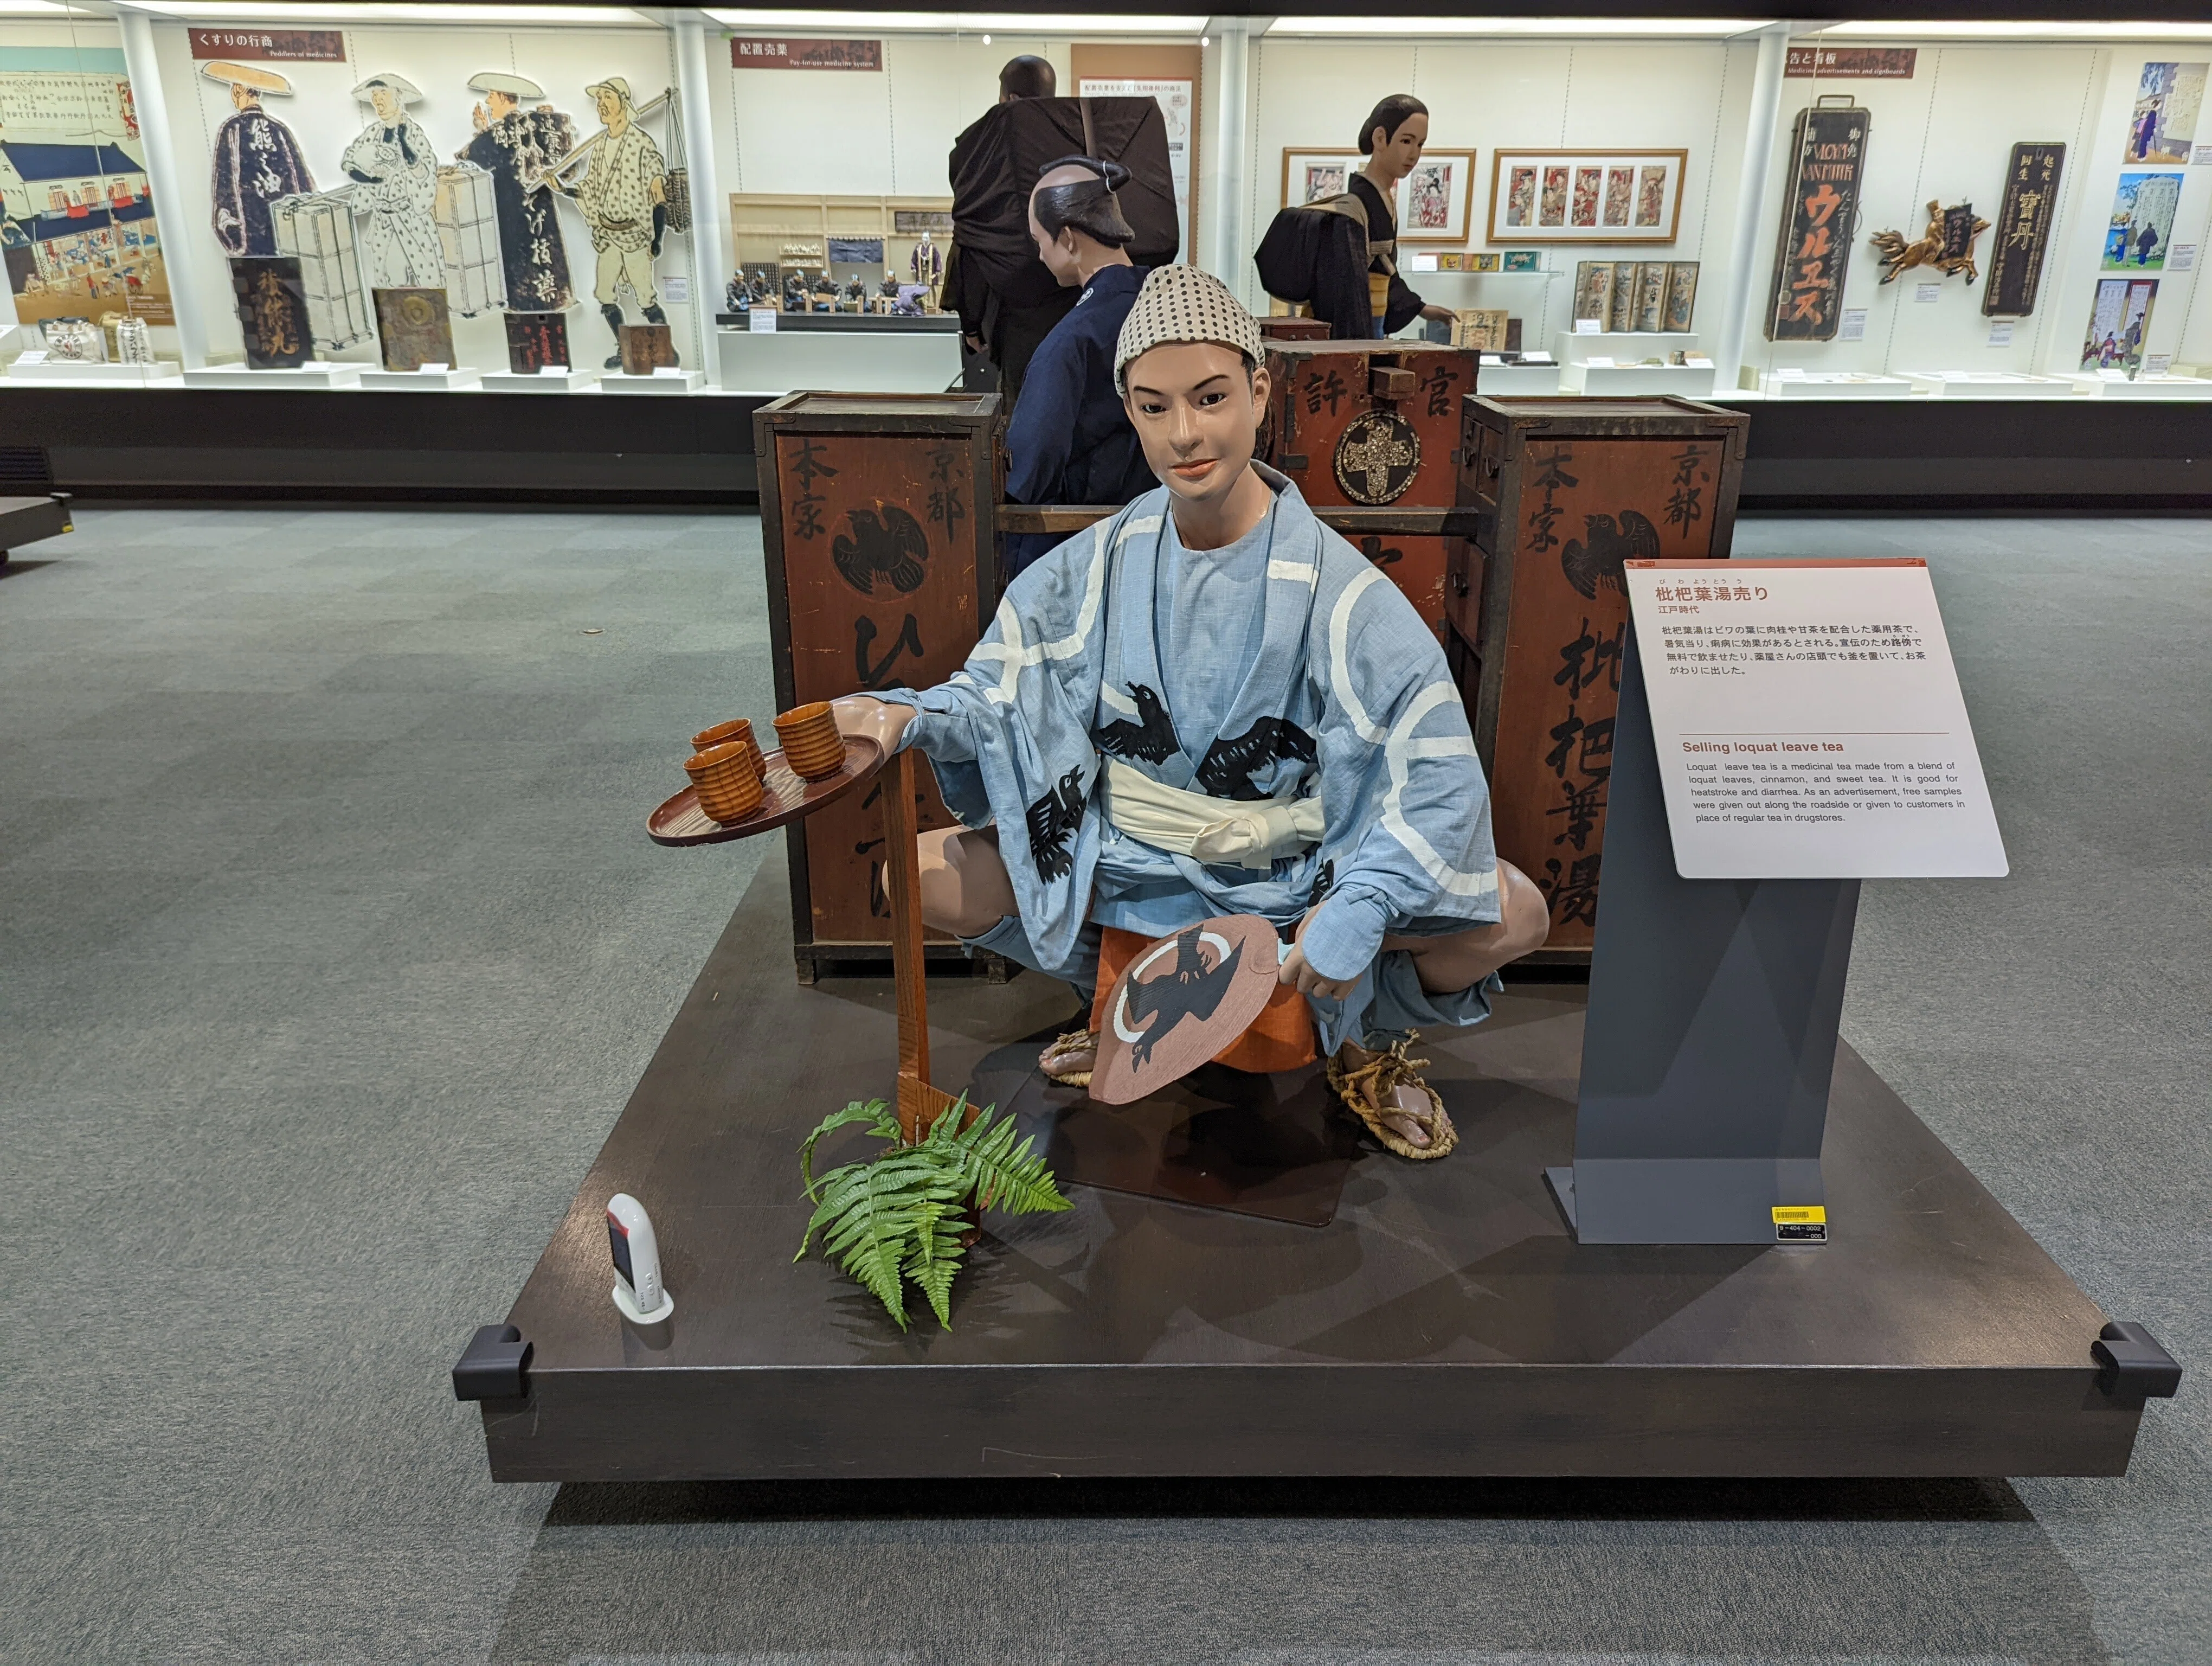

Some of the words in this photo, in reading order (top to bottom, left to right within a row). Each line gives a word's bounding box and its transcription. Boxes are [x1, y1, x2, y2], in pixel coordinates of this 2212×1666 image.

[199, 34, 273, 47] くすりの行商
[740, 43, 788, 56] 配置売薬
[1785, 52, 1836, 65] 告と看板
[789, 438, 839, 540] 本家
[925, 442, 966, 544] 京都
[1663, 445, 1710, 540] 京都
[1526, 445, 1579, 553] 本家
[1655, 586, 1767, 602] 枇杷葉湯売り
[1658, 605, 1700, 614] 江戸時代
[1662, 625, 1918, 635] 枇杷葉湯はビワの葉に肉桂や甘茶を配合した薬用茶で、
[1667, 651, 1926, 662] 無料で飲ませたり、薬屋さんの店頭でも釜を置いて、お茶
[1670, 666, 1746, 675] がわりに出した。
[1682, 741, 1731, 754] Selling
[1733, 741, 1779, 754] loquat
[1781, 741, 1819, 752] leave
[1821, 742, 1844, 752] tea
[1686, 763, 1718, 773] Loquat
[1724, 762, 1749, 771] leave
[1769, 762, 1778, 771] is
[1791, 762, 1834, 771] medicinal
[1855, 762, 1881, 770] made
[1883, 762, 1905, 770] from
[1917, 762, 1943, 770] blend
[1946, 761, 1955, 770] of
[1688, 776, 1718, 785] loquat
[1722, 776, 1755, 785] leaves,
[1760, 775, 1809, 784] cinnamon,
[1813, 775, 1831, 783] and
[1836, 775, 1864, 783] sweet
[1892, 774, 1899, 783] It
[1903, 774, 1912, 783] is
[1917, 774, 1941, 784] good
[1945, 774, 1958, 783] for
[1690, 788, 1738, 796] heatstroke
[1741, 788, 1758, 796] and
[1761, 787, 1801, 796] diarrhea.
[1803, 787, 1816, 796] As
[1834, 787, 1900, 797] advertisement,
[1902, 787, 1921, 796] free
[1924, 787, 1962, 797] samples
[1719, 801, 1744, 811] given
[1746, 801, 1762, 809] out
[1764, 800, 1790, 811] along
[1792, 800, 1808, 809] the
[1810, 800, 1850, 809] roadside
[1866, 800, 1891, 810] given
[1956, 800, 1965, 808] in
[1695, 813, 1720, 824] place
[1722, 813, 1731, 822] of
[1733, 813, 1765, 824] regular
[1783, 813, 1793, 822] in
[1794, 813, 1846, 823] drugstores.
